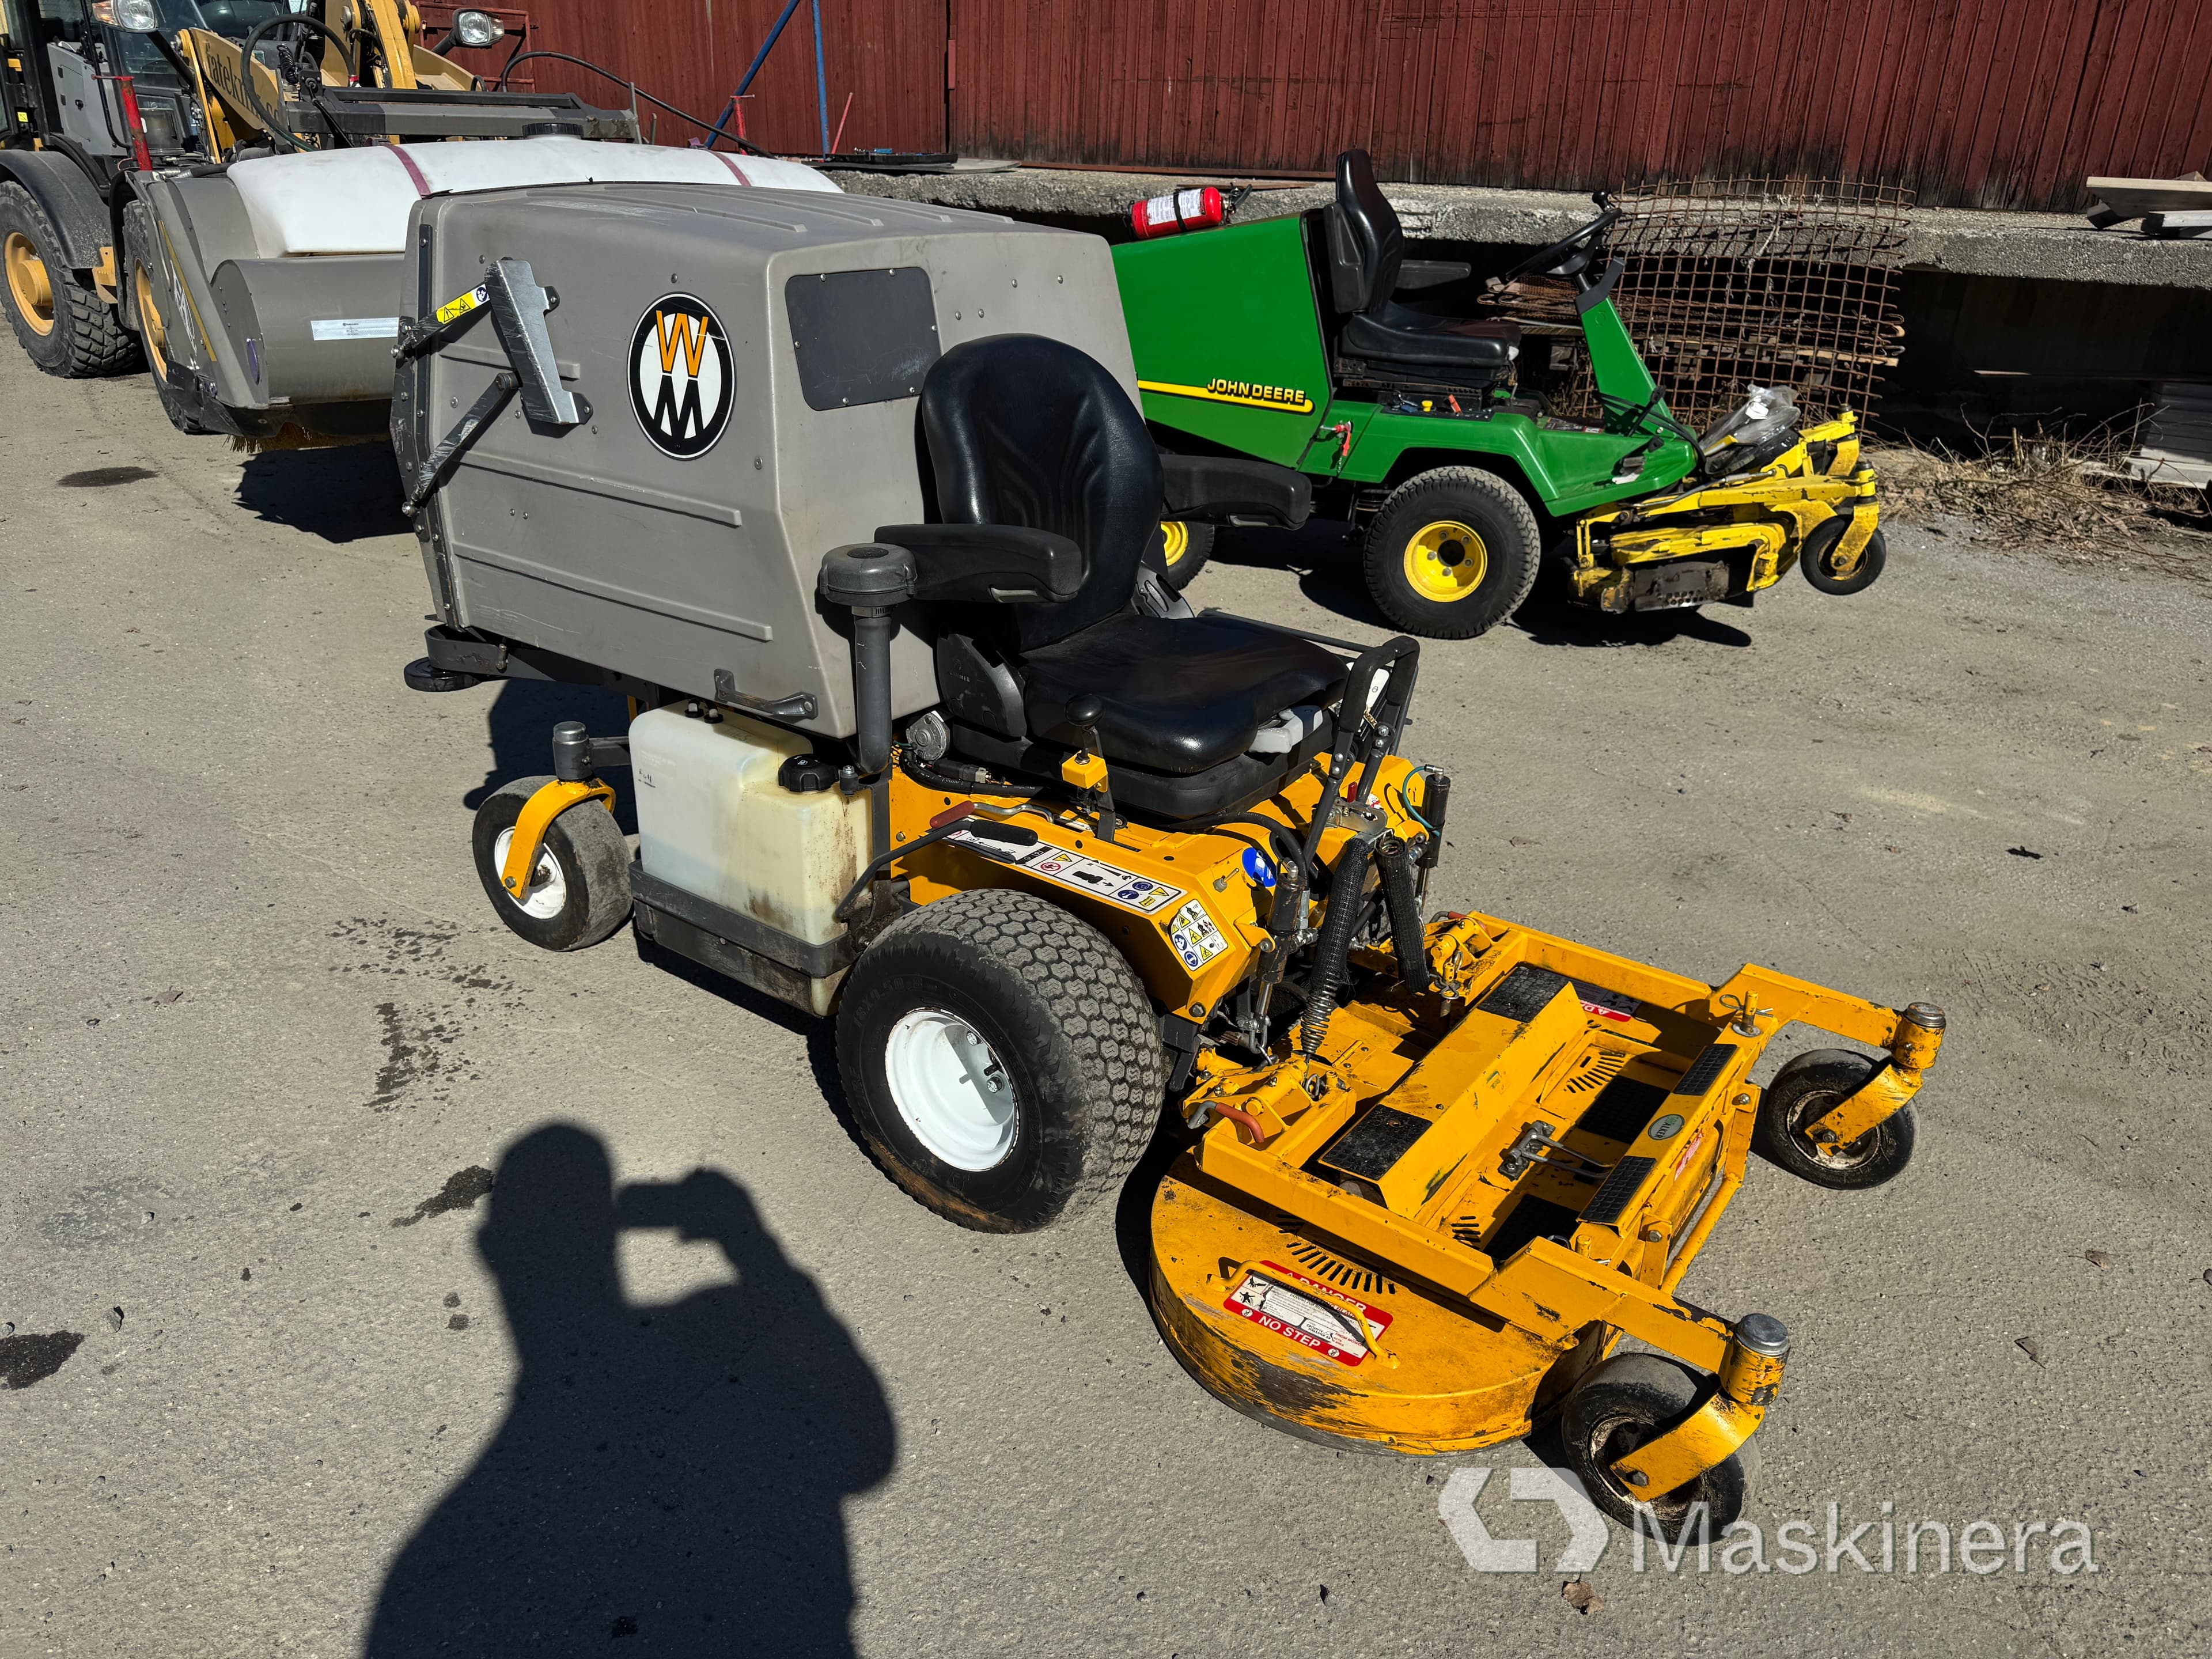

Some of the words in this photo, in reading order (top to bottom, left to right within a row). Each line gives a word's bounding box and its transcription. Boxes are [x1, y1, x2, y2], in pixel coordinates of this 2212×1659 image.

[1207, 378, 1250, 396] JOHN
[1251, 384, 1305, 404] DEERE
[1258, 1316, 1282, 1330] NO
[1283, 1327, 1321, 1347] STEP
